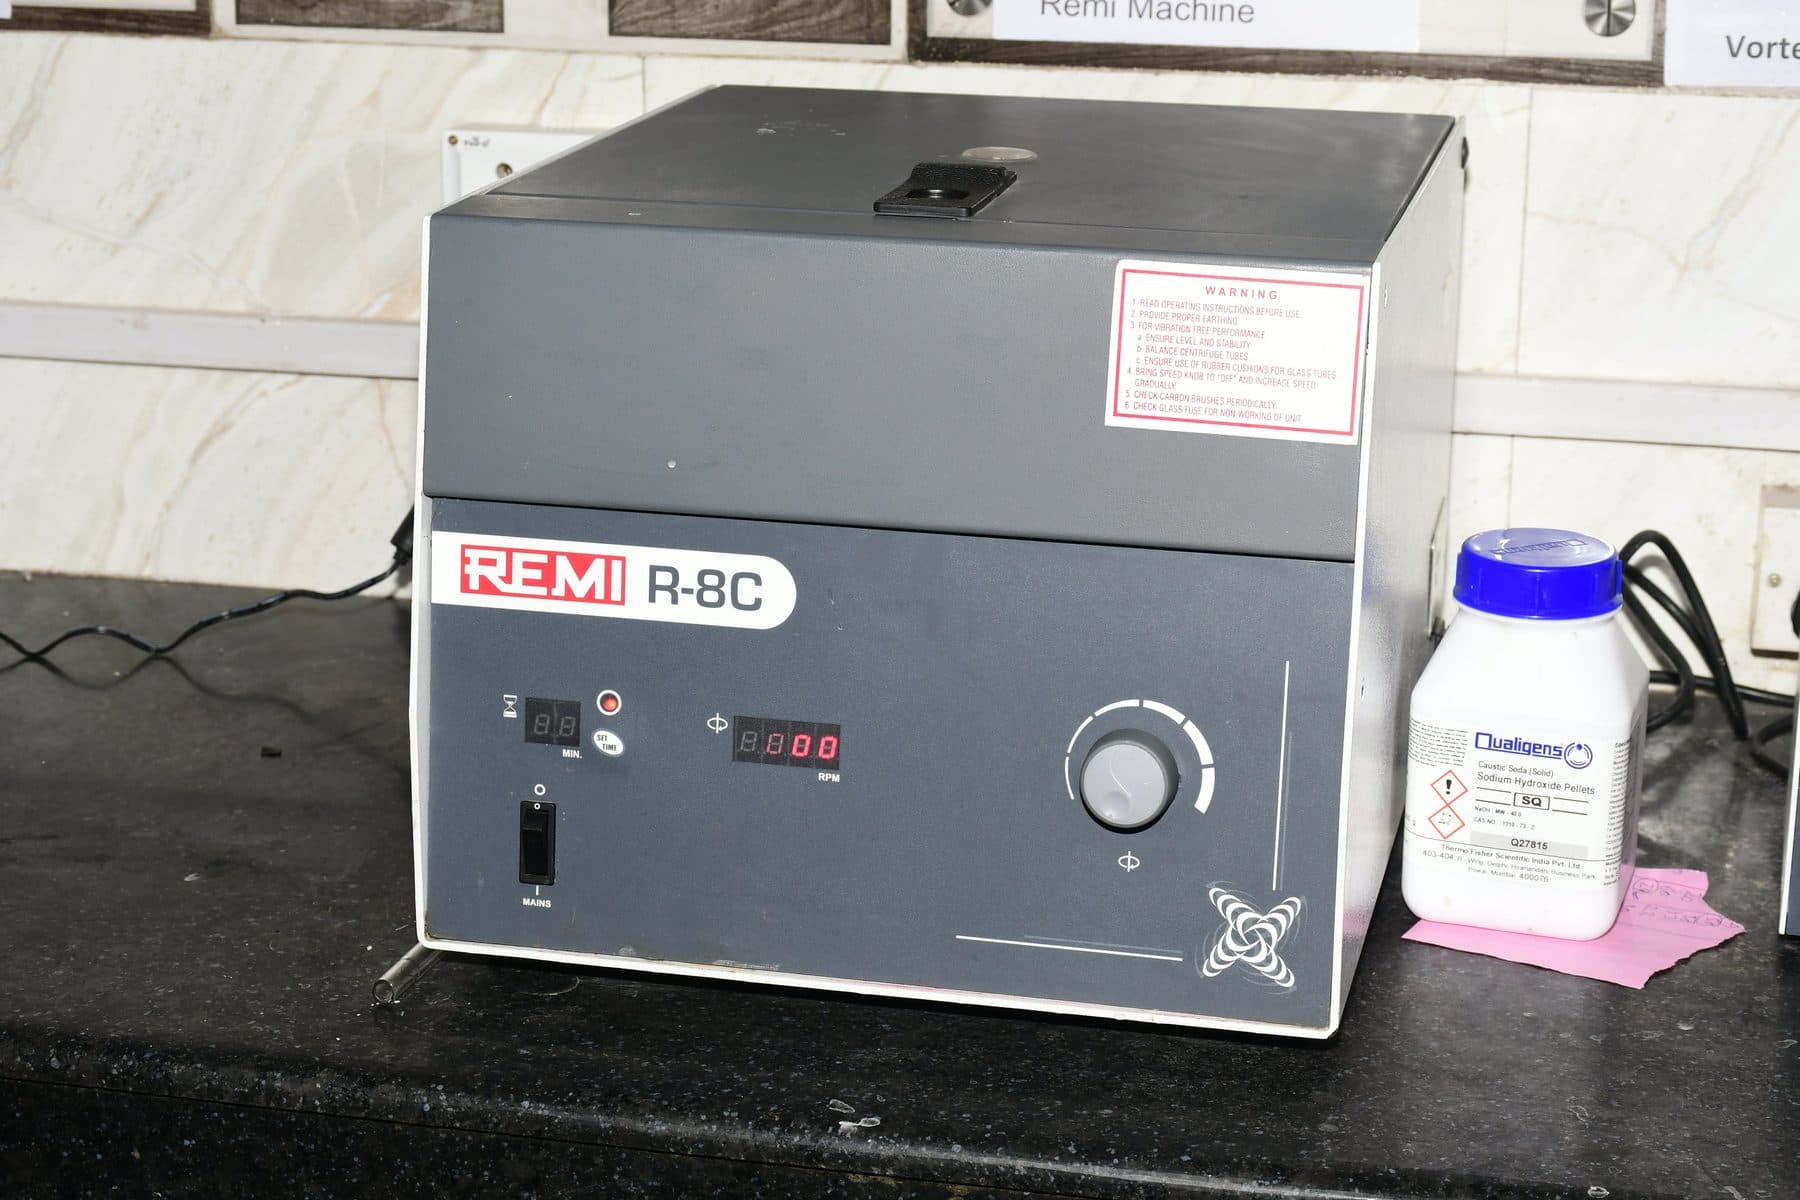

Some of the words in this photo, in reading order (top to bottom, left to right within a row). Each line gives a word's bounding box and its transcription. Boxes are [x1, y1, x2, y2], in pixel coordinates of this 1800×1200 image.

[1041, 0, 1116, 18] Remi
[1128, 0, 1255, 23] Machine
[1726, 35, 1800, 60] Vorte
[1206, 286, 1278, 300] WARNING
[1140, 298, 1159, 308] READ
[1161, 300, 1200, 312] OPERATING
[1203, 303, 1254, 316] INSTRUCTIONS
[1256, 307, 1283, 317] BEFORE
[1139, 310, 1169, 320] PROVIDE
[1172, 312, 1200, 322] PROPER
[1138, 321, 1153, 330] FOR
[1155, 323, 1191, 333] VIBRATION
[1193, 325, 1211, 335] FREE
[1213, 327, 1265, 339] PERFORMANCE
[1146, 334, 1174, 343] ENSURE
[1176, 336, 1197, 345] LEVEL
[1199, 338, 1214, 347] AND
[1216, 339, 1251, 349] STABILITY
[1146, 345, 1177, 355] BALANCE
[1180, 348, 1223, 359] CENTRIFUGE
[1226, 351, 1249, 361] TUBES
[1144, 356, 1173, 366] ENSURE
[1175, 359, 1190, 368] USE
[1191, 360, 1200, 368] OF
[1201, 361, 1230, 371] RUBBER
[1232, 363, 1269, 374] CUSHIONS
[1271, 366, 1285, 376] FOR
[1287, 367, 1311, 378] GLASS
[1136, 367, 1157, 377] BRING
[1160, 369, 1182, 379] SPEED
[1184, 371, 1204, 380] KNOB
[1206, 373, 1215, 381] TO
[1239, 375, 1253, 384] AND
[1256, 377, 1290, 388] INCREASE
[1293, 379, 1316, 389] SPEED
[1134, 390, 1158, 400] CHECK
[1160, 392, 1190, 402] CARBON
[1191, 395, 1224, 405] BRUSHES
[1133, 401, 1157, 411] CHECK
[1159, 404, 1183, 413] GLASS
[1184, 405, 1201, 415] FUSE
[1204, 407, 1218, 416] FOR
[1221, 408, 1272, 421] NON-WORKING
[1274, 412, 1283, 421] OF
[464, 547, 622, 601] REMI
[649, 564, 763, 612] R-8C
[597, 734, 608, 742] SET
[1475, 732, 1563, 760] Qualigens
[562, 749, 582, 759] MIN.
[602, 743, 617, 752] TIME
[1478, 760, 1505, 771] Caustic
[1508, 765, 1527, 774] Soda
[1529, 767, 1554, 778] (Solid)
[818, 773, 840, 782] RPM
[1477, 771, 1511, 784] Sodium
[1514, 777, 1561, 790] Hydroxide
[1564, 783, 1595, 794] Pellets
[1522, 796, 1542, 807] SQ
[1511, 838, 1548, 850] Q27815
[1441, 844, 1469, 854] Thermo
[1471, 849, 1493, 857] Fisher
[1496, 853, 1529, 863] Scientific
[1532, 857, 1550, 865] India
[1520, 873, 1549, 882] 400076
[522, 898, 551, 908] MAINS
